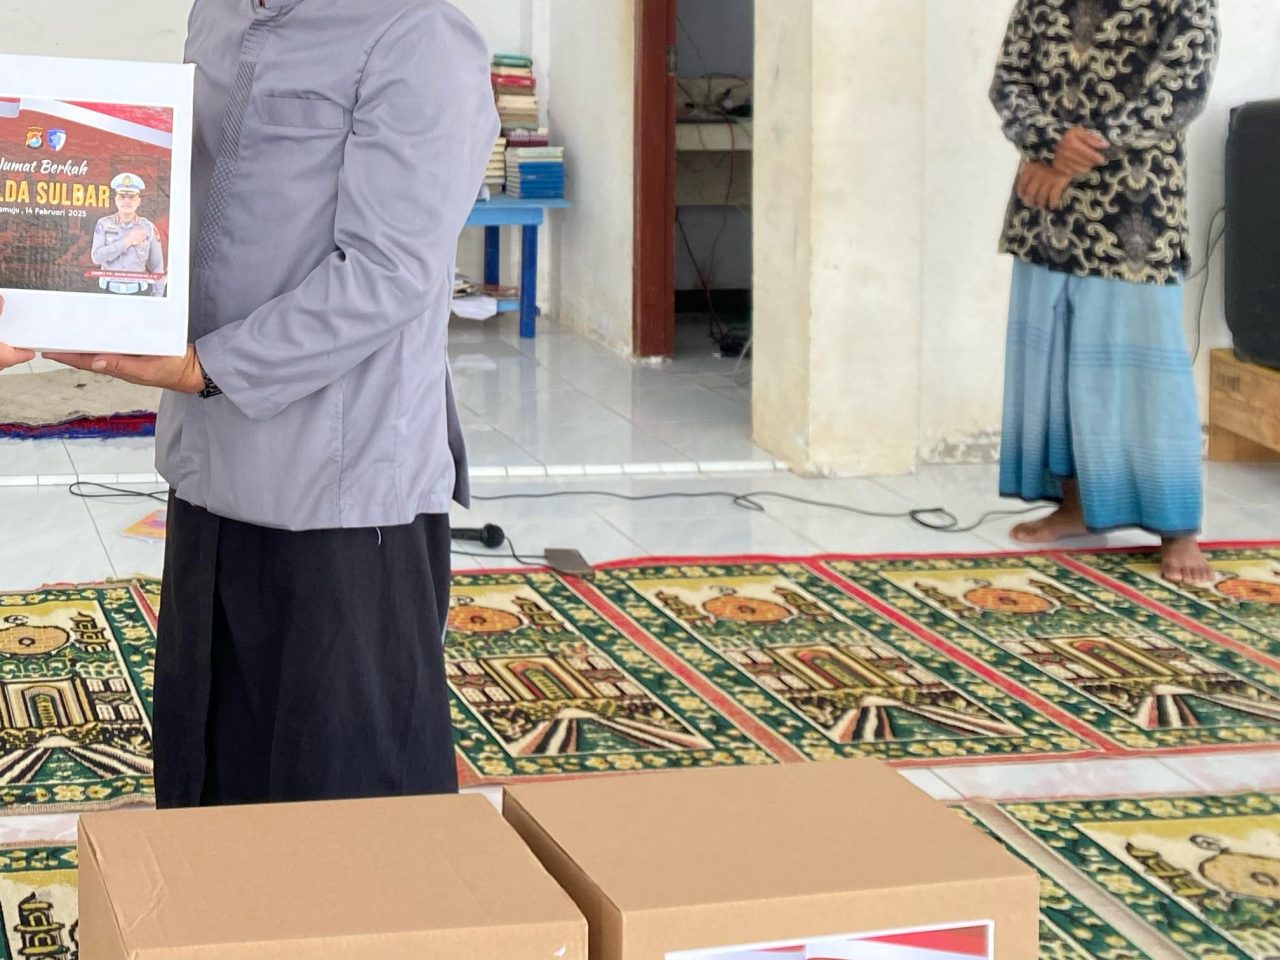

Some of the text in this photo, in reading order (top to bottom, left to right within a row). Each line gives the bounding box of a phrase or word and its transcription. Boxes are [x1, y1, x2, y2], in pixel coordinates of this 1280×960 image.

[40, 159, 88, 176] Berkah
[36, 181, 110, 208] SULBAR
[25, 206, 33, 214] 14
[34, 208, 65, 217] Februari
[68, 209, 87, 217] 2025
